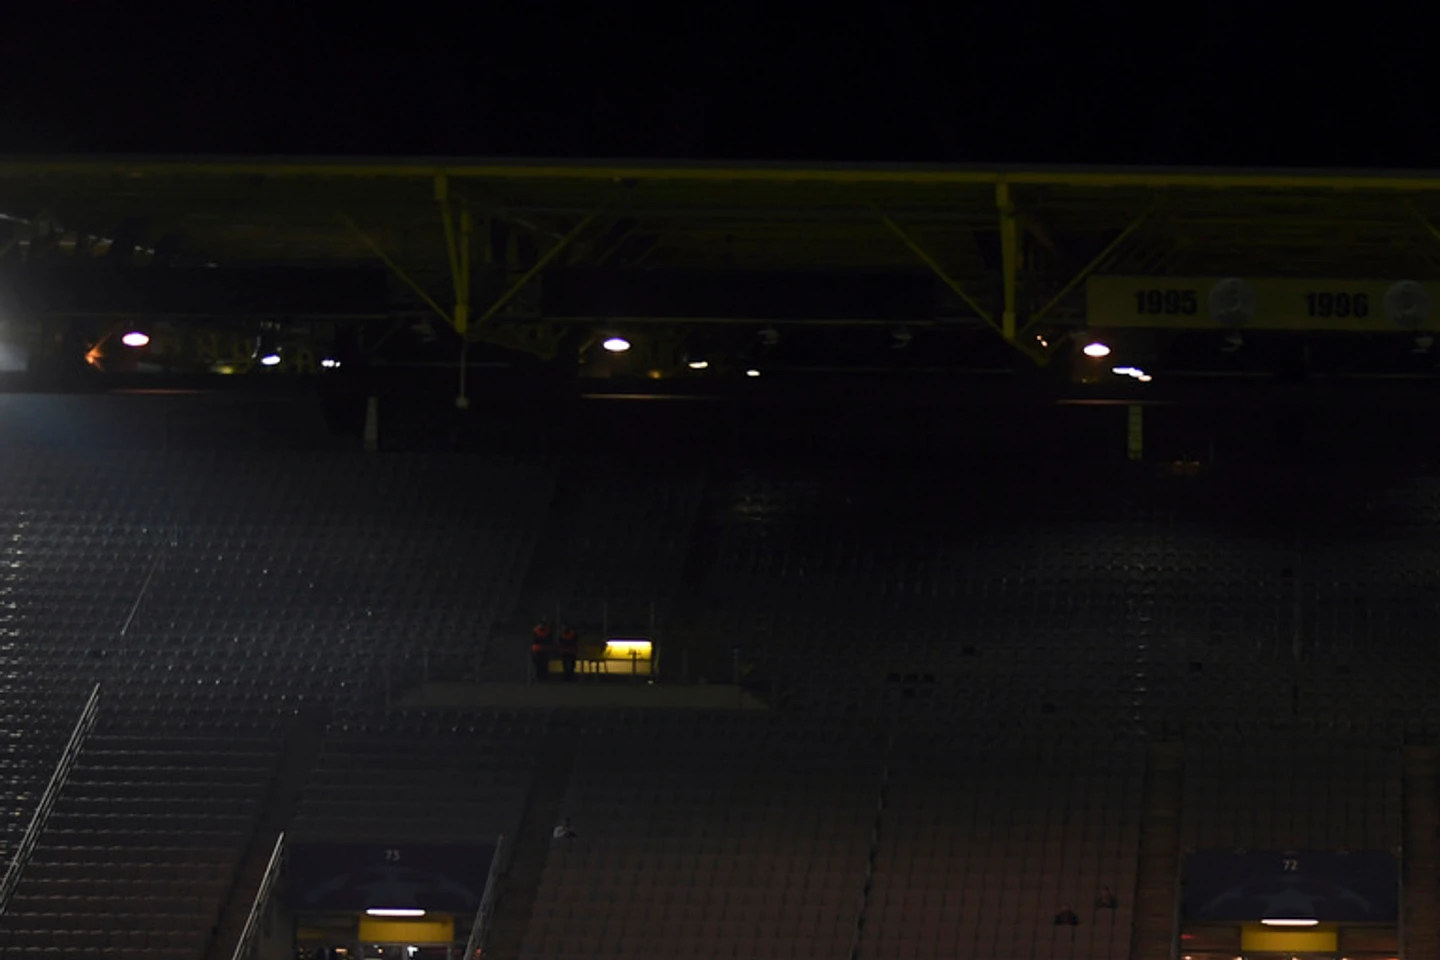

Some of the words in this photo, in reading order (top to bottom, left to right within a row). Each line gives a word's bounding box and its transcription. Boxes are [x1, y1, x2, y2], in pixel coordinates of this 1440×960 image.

[1134, 289, 1197, 315] 1995
[1307, 291, 1369, 318] 1996
[1282, 858, 1299, 872] 72
